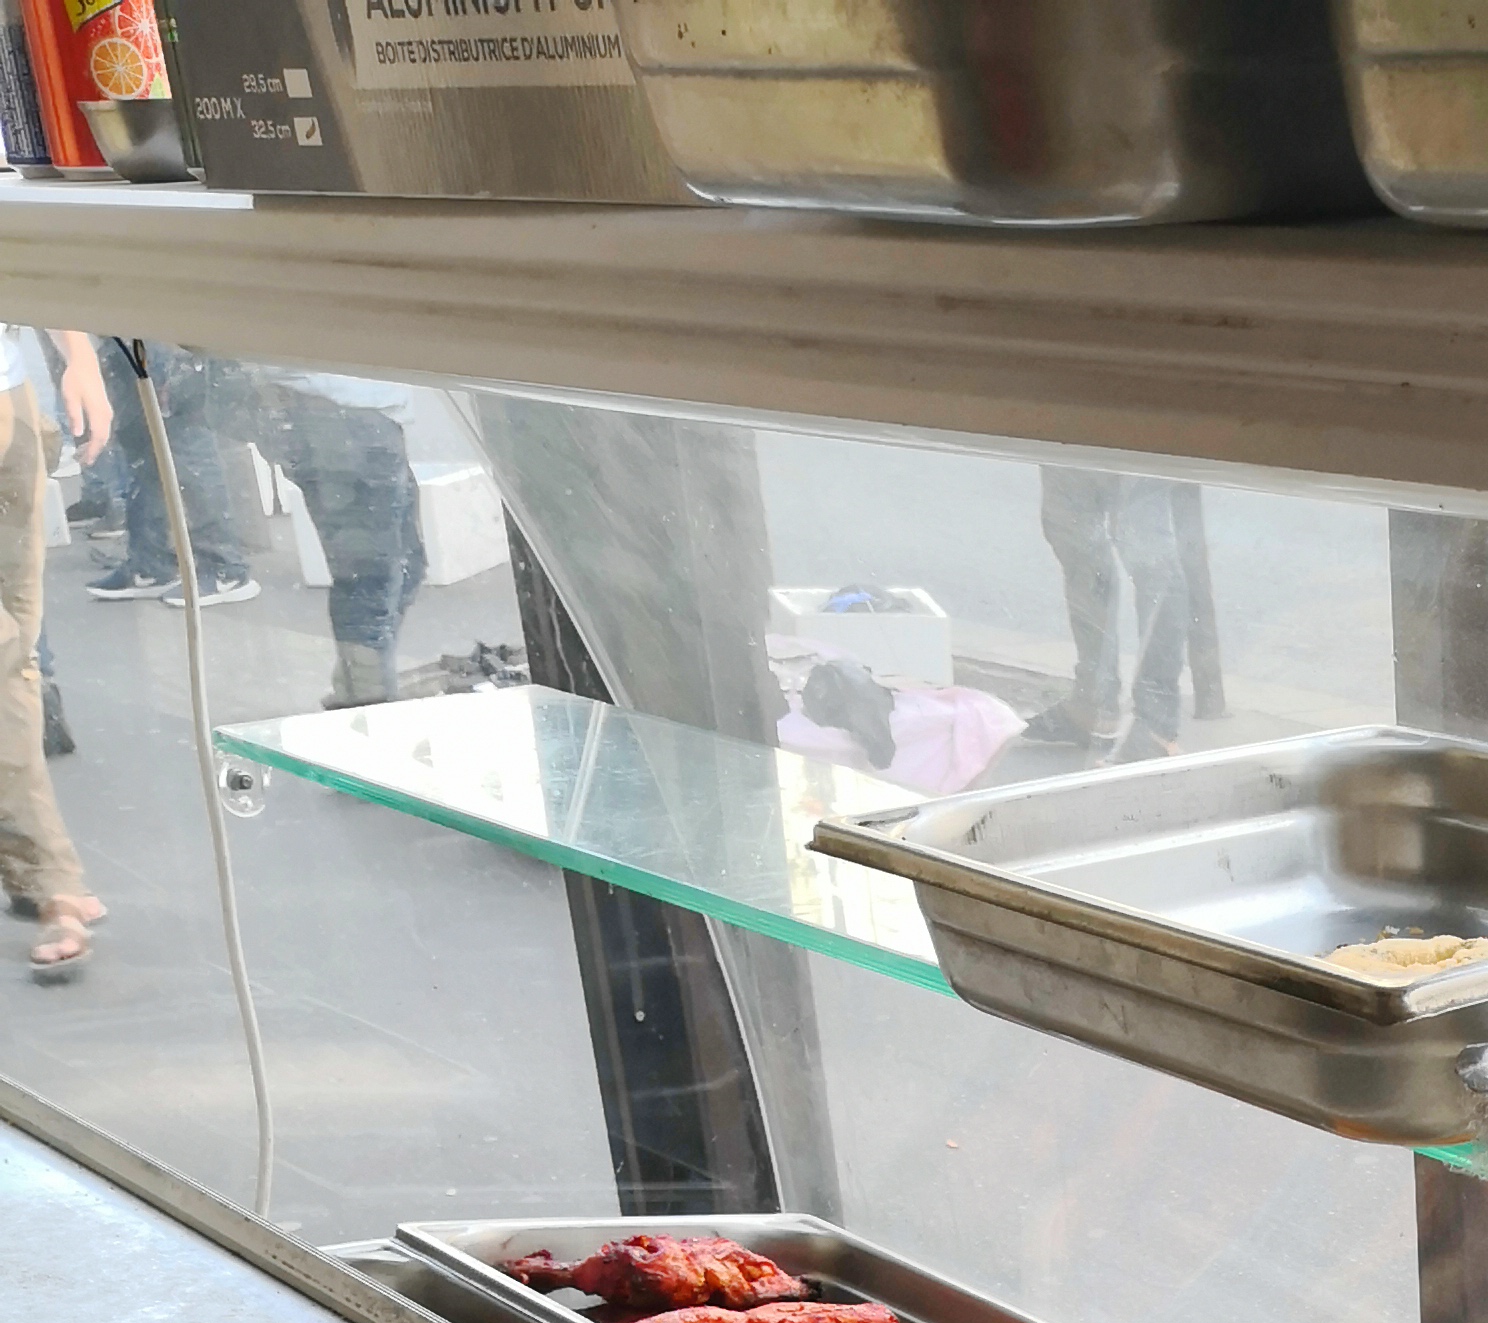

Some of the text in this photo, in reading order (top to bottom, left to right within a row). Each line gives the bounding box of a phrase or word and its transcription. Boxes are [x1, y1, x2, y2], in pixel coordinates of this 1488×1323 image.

[375, 33, 622, 64] BOITE DISTRIBUTRICE D'ALUMINIUM
[267, 78, 284, 92] cm
[194, 97, 246, 120] 200 M X
[276, 124, 291, 139] cm
